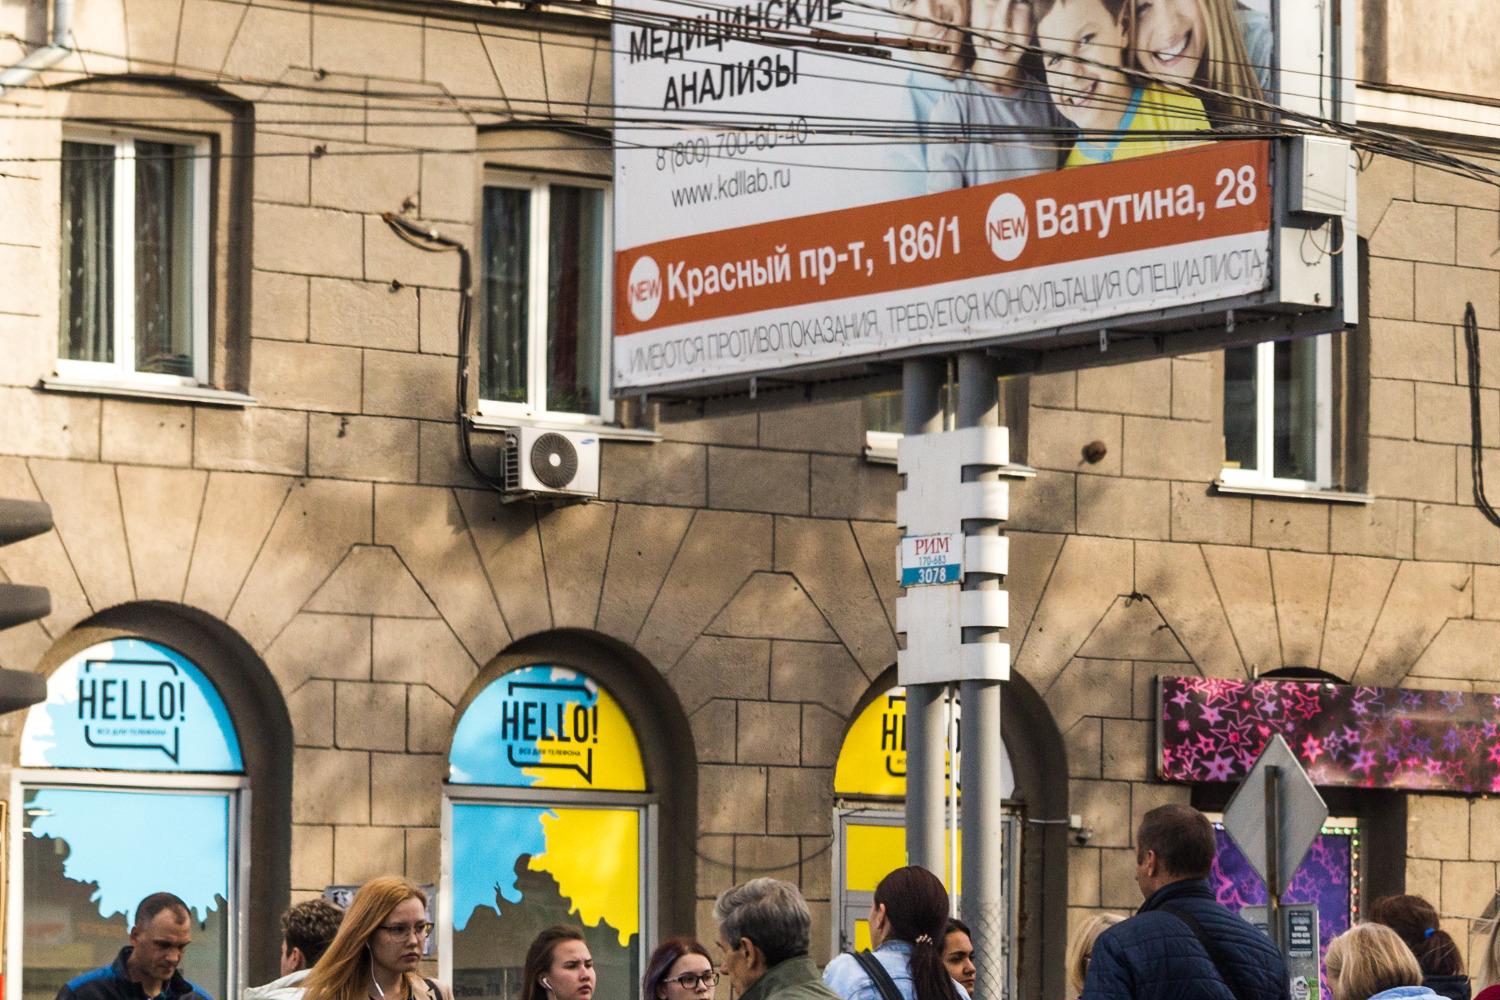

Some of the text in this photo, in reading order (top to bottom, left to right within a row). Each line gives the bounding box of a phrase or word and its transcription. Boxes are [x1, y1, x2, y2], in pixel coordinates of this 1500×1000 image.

[629, 0, 844, 65] МЕДИЦИНСКИЕ
[663, 49, 799, 110] АНАЛИЗЫ
[655, 146, 666, 171] 8
[670, 136, 711, 174] (800)
[671, 167, 791, 208] www.kdllab.ru
[1036, 165, 1257, 239] Ватутина, 28
[988, 214, 1029, 241] NEW
[667, 214, 961, 307] Красный пр-т, 186/1
[630, 278, 661, 301] NEW
[886, 294, 980, 335] ТРЕБУЕТСЯ
[983, 269, 1120, 320] КОНСУЛЬТАЦИЯ
[915, 536, 950, 556] РИМ
[918, 567, 946, 583] 3078
[78, 679, 185, 722] HELLO!
[502, 701, 598, 744] HELLO!
